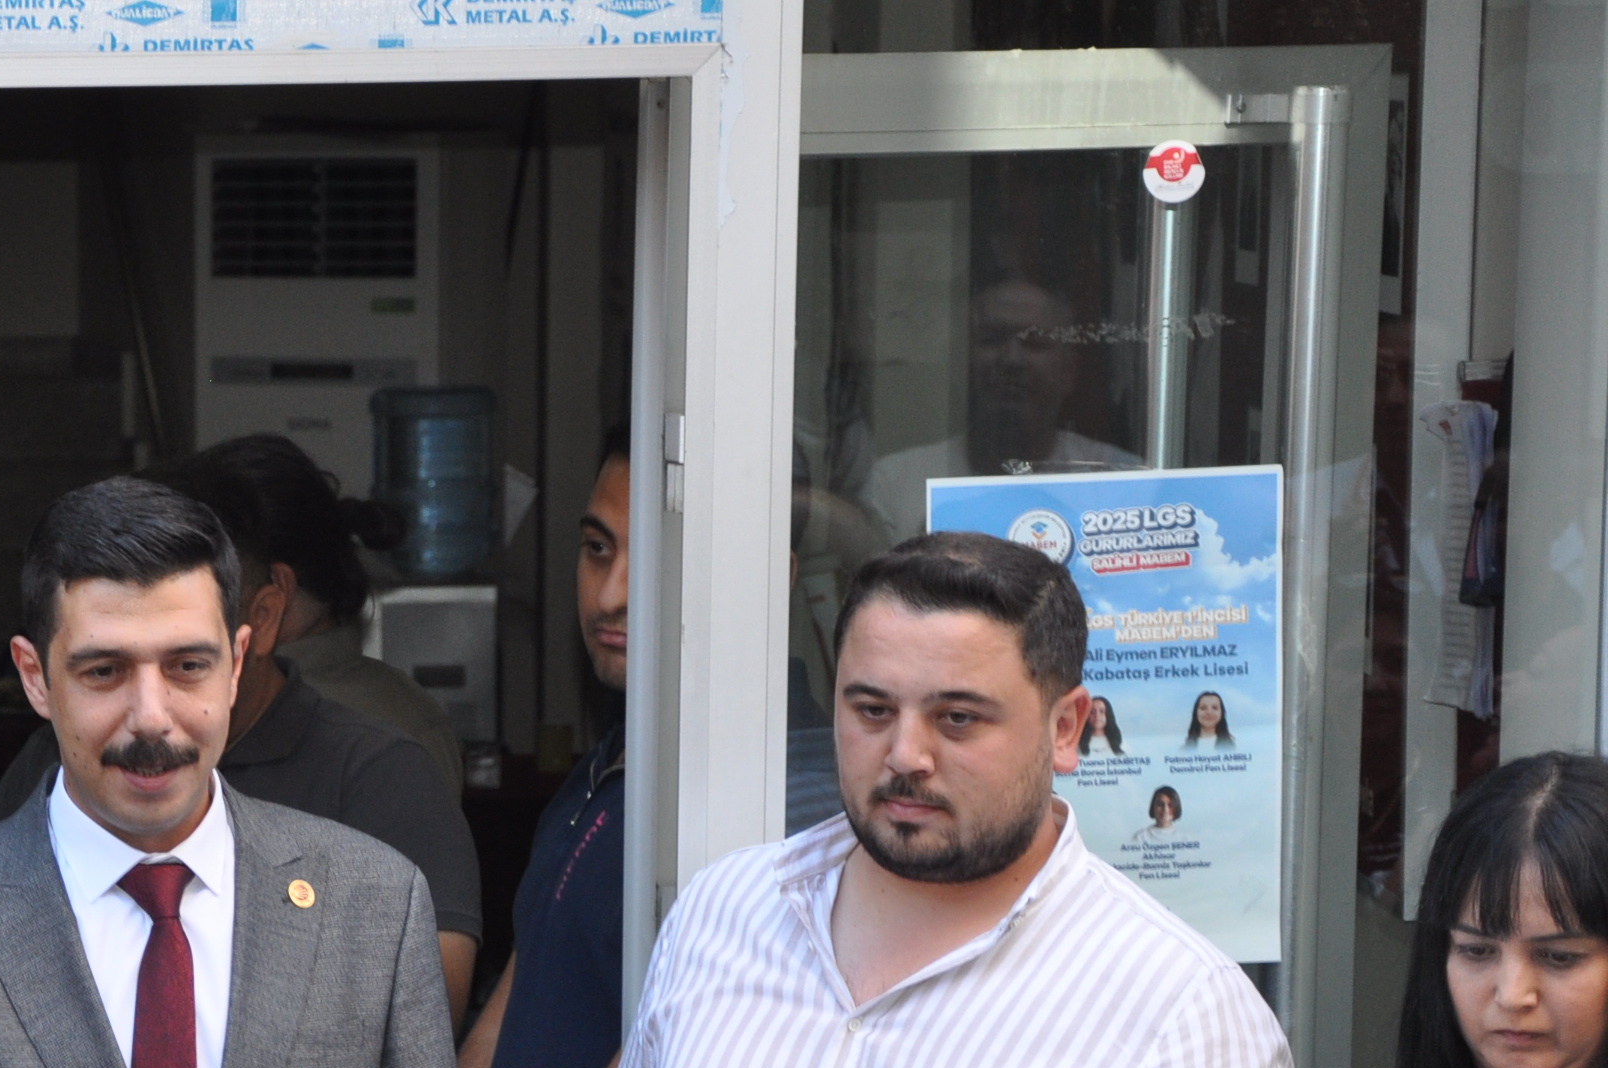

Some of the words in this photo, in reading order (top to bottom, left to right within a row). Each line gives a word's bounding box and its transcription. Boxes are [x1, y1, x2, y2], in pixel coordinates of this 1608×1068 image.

[47, 15, 84, 33] A.Ş.
[466, 9, 532, 24] METAL
[538, 8, 576, 26] A.Ş.
[1082, 509, 1141, 534] 2025
[1142, 503, 1195, 530] LGS
[1118, 606, 1184, 627] TÜRKİYE
[1114, 623, 1218, 643] MABEM'DEN
[1106, 647, 1157, 664] Eymen
[1160, 644, 1238, 660] ERYILMAZ
[1083, 666, 1151, 682] Kabataş
[1155, 664, 1200, 679] Erkek
[1204, 661, 1249, 677] Lisesi
